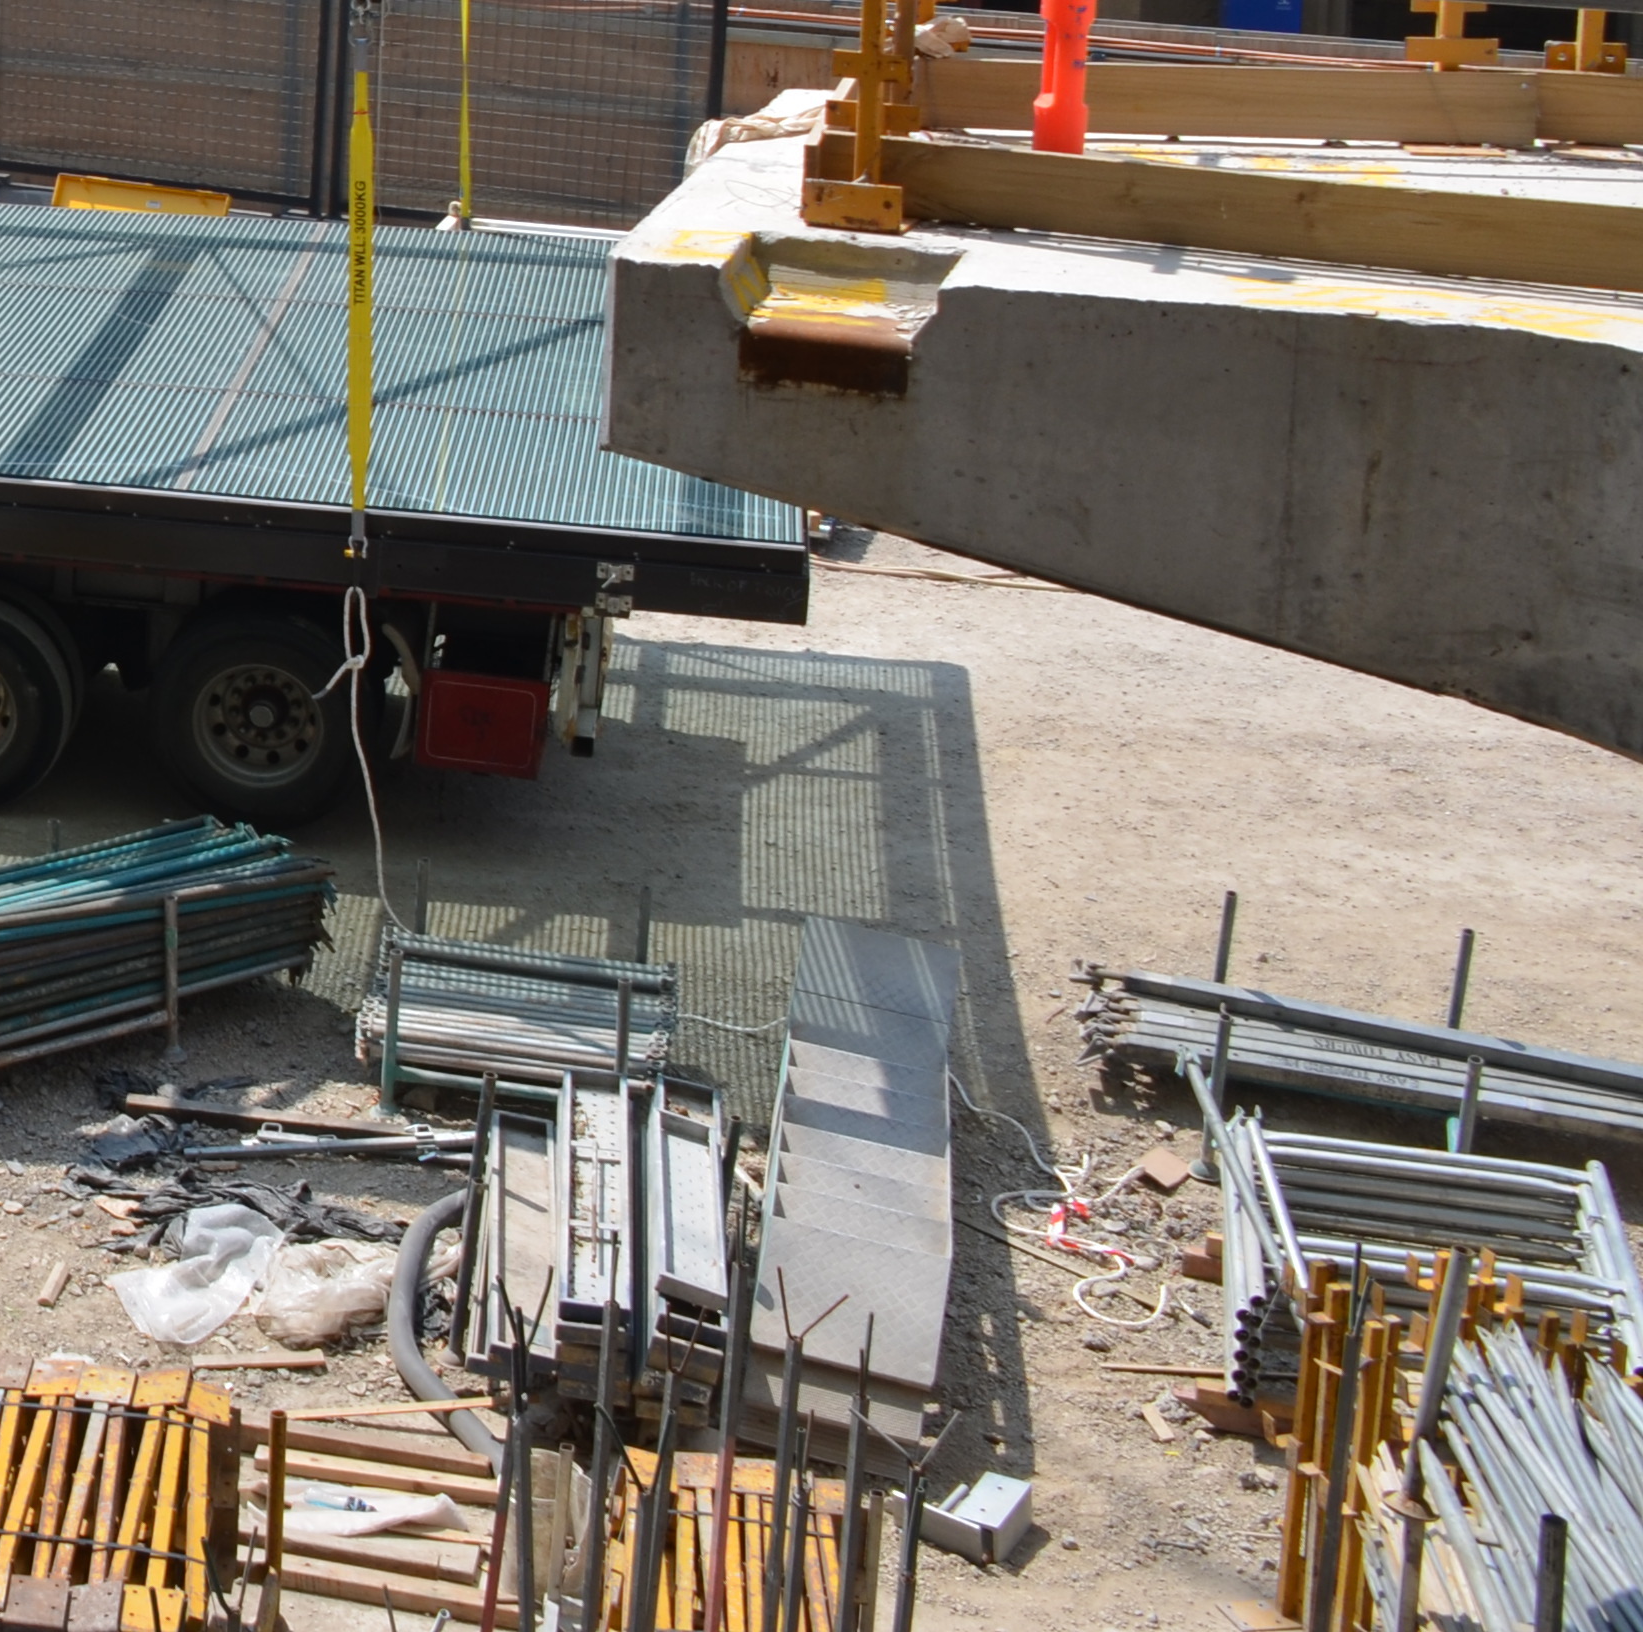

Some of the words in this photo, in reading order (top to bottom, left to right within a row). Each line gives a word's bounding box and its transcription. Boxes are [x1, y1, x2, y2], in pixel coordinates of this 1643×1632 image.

[354, 180, 366, 234] 3000KG
[354, 269, 365, 306] TITAN
[1312, 1037, 1387, 1059] TOWERS
[1394, 1051, 1442, 1069] EASY
